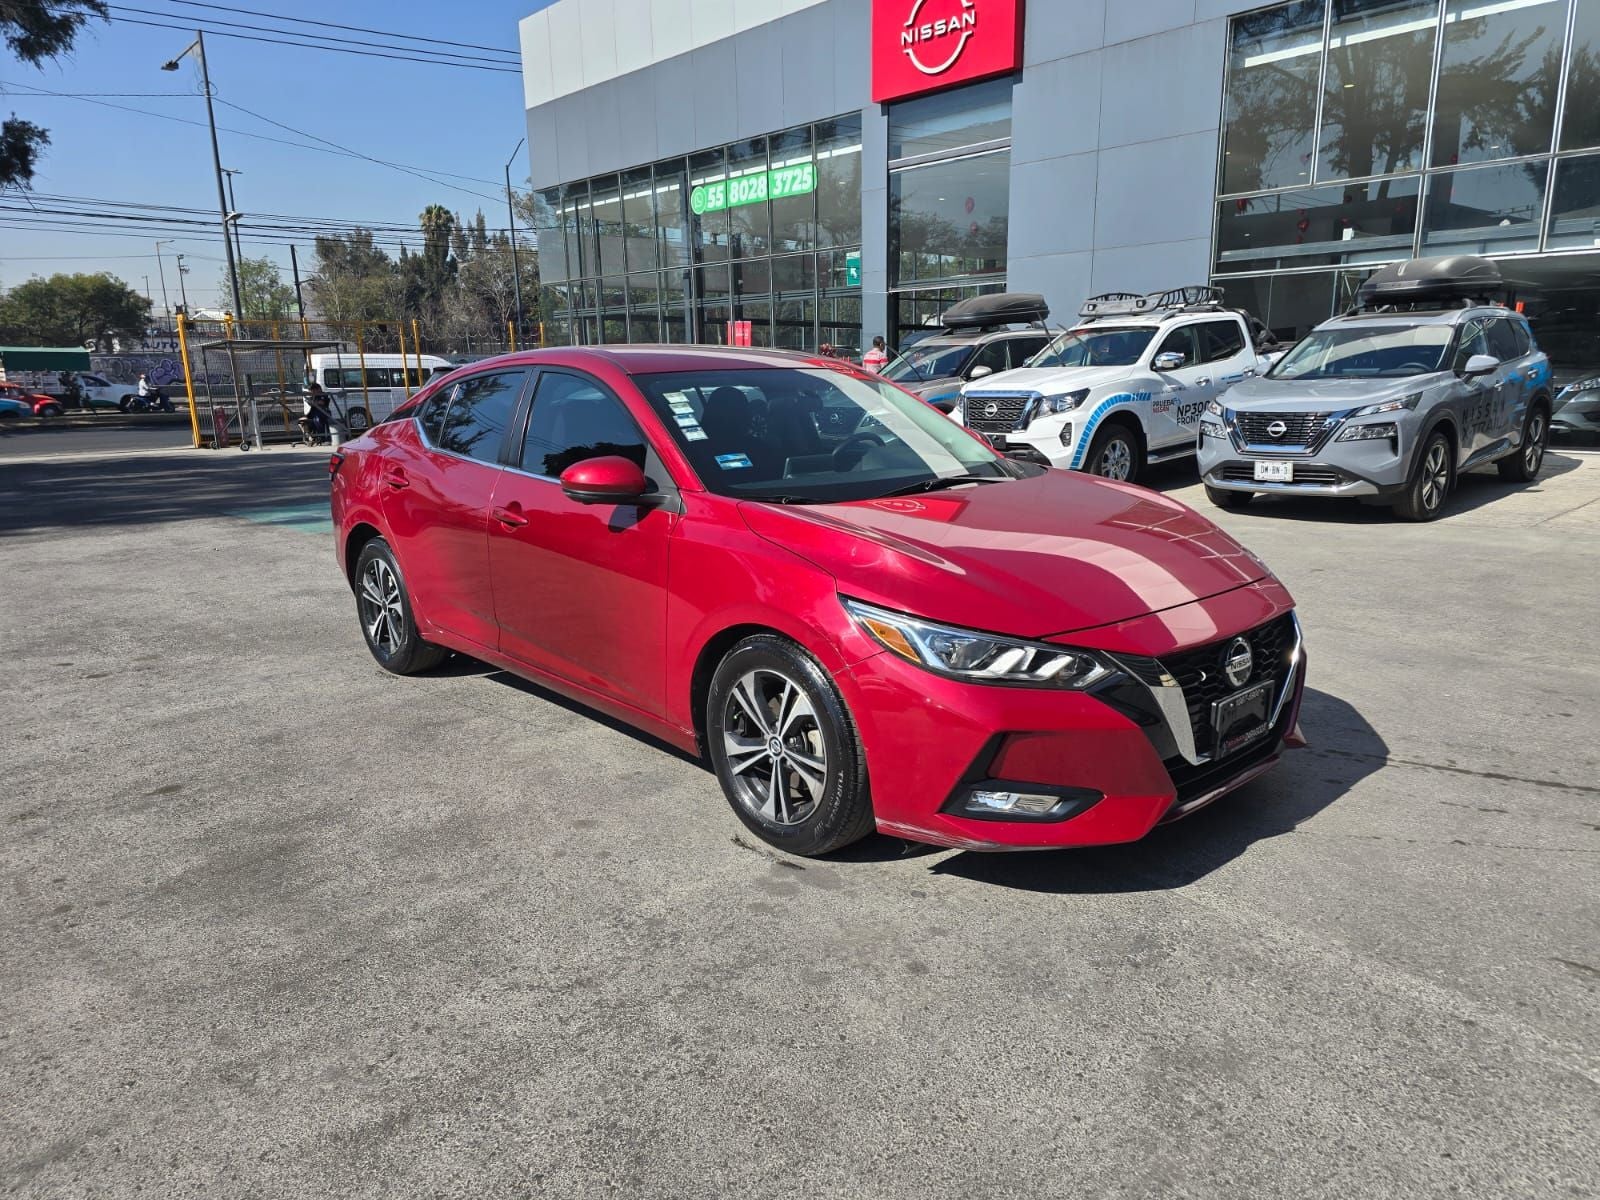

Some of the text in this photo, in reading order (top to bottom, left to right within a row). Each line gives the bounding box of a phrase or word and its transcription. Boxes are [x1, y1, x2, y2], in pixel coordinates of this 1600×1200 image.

[900, 9, 976, 46] NISSAN
[706, 164, 813, 209] 55 8028 3725
